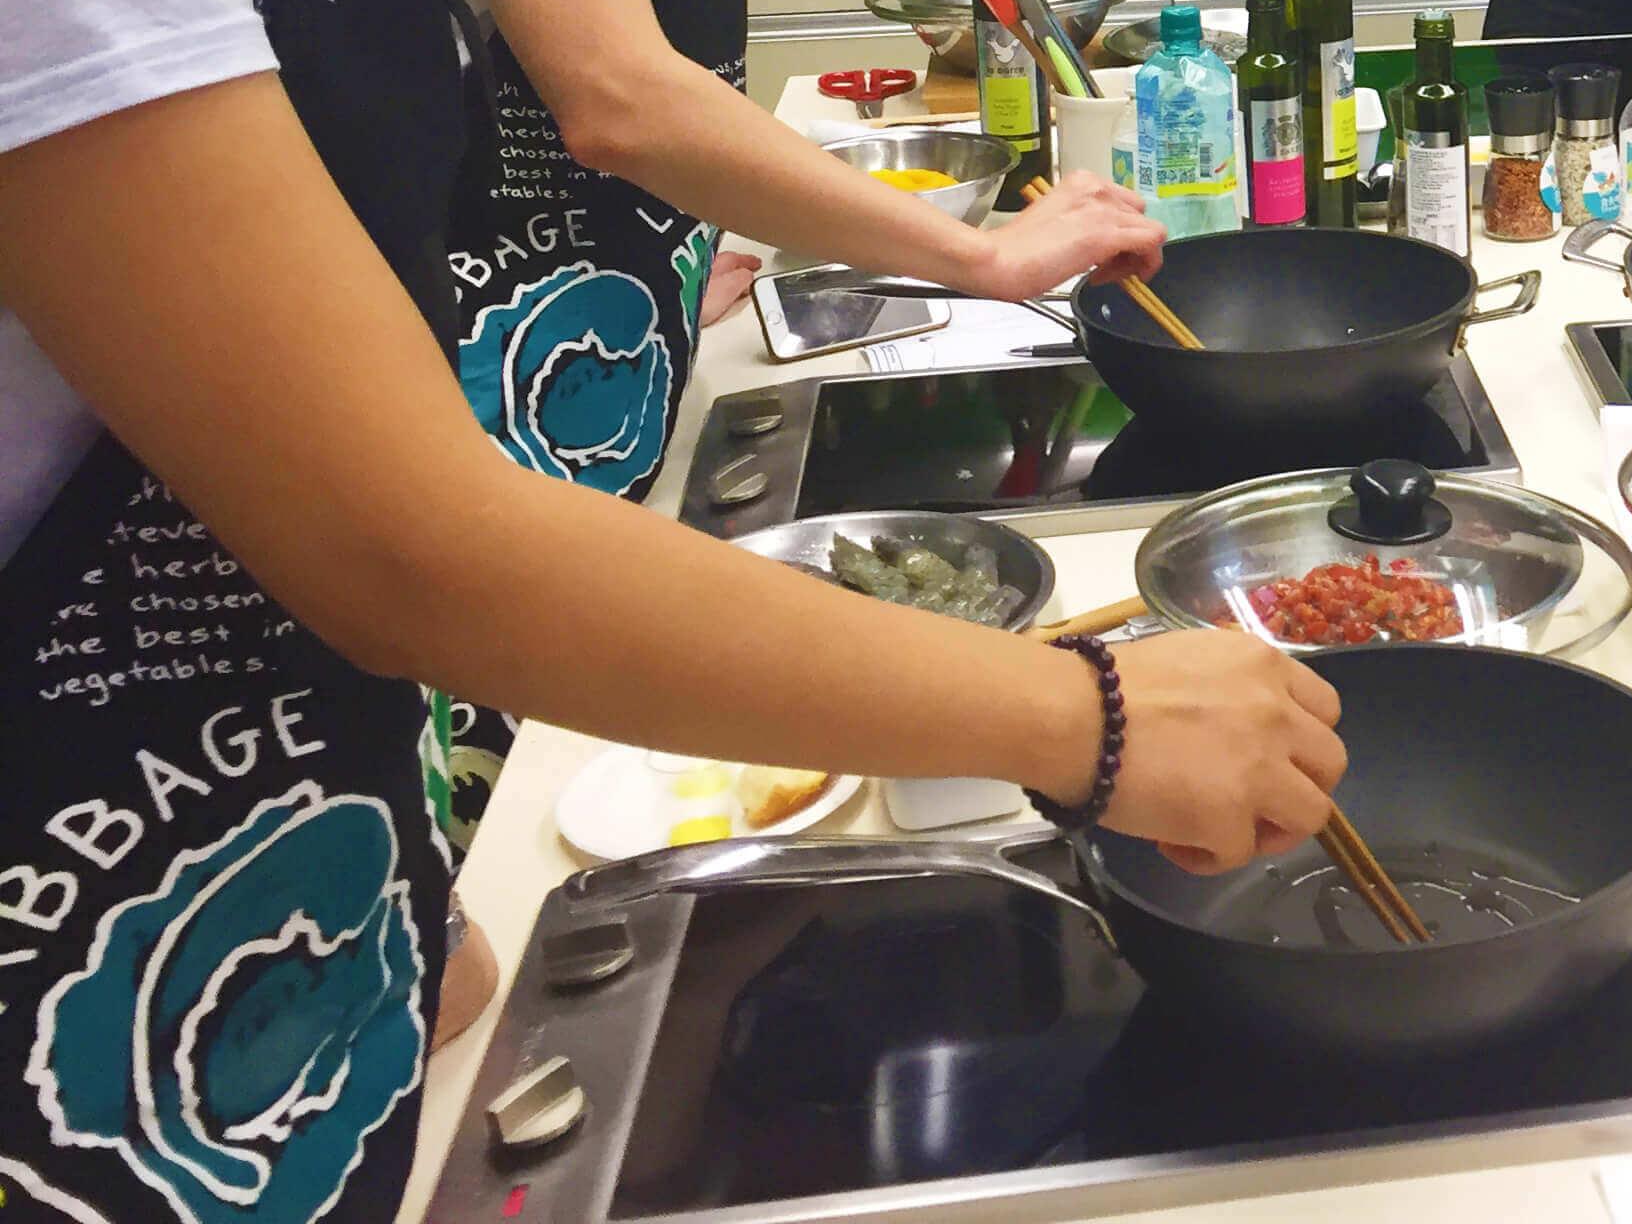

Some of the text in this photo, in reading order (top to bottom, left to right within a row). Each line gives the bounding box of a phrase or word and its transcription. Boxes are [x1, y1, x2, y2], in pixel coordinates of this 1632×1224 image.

[500, 106, 551, 119] ever
[498, 123, 567, 142] herb
[500, 145, 571, 160] chosen
[503, 163, 552, 180] best
[567, 170, 587, 180] in
[489, 184, 574, 199] etables.
[448, 208, 596, 296] BAGE
[130, 551, 238, 578] herb
[130, 592, 265, 613] chosen
[34, 619, 296, 664] the best in
